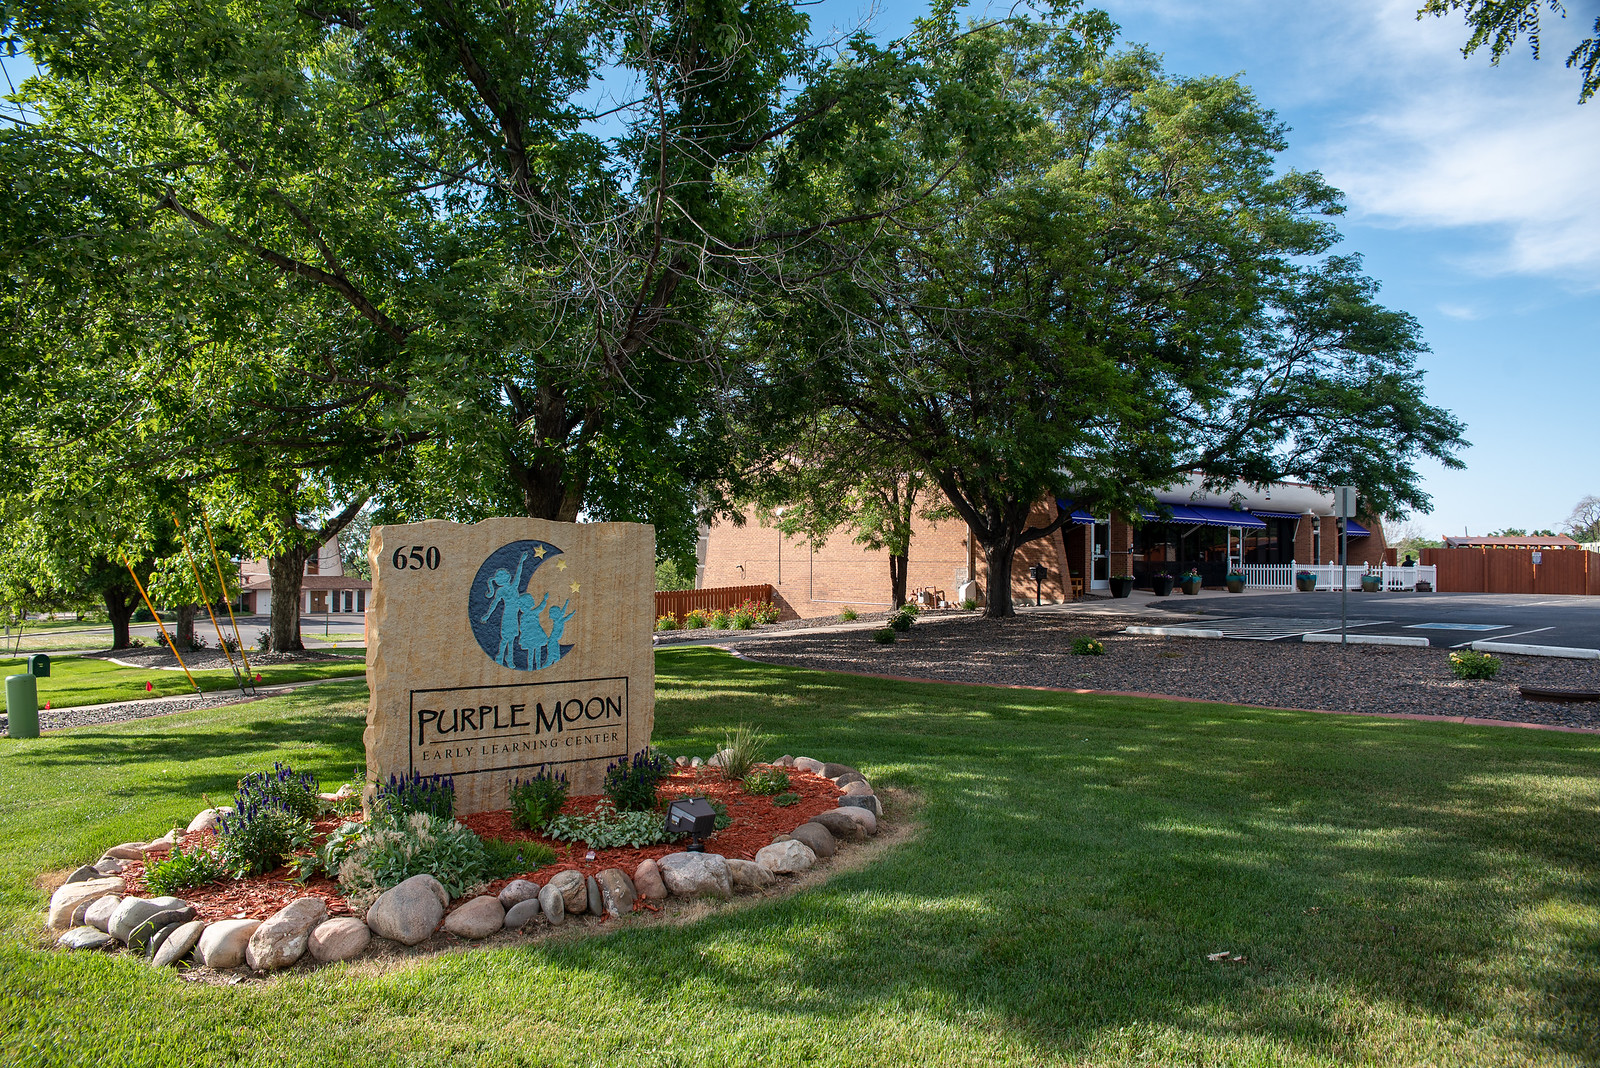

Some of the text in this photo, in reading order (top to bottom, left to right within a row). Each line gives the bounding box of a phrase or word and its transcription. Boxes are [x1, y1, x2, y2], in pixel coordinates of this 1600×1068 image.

[392, 545, 441, 570] 650
[418, 696, 622, 746] PURPLE MOON
[422, 732, 619, 761] EARLY LEARNING CENTER
